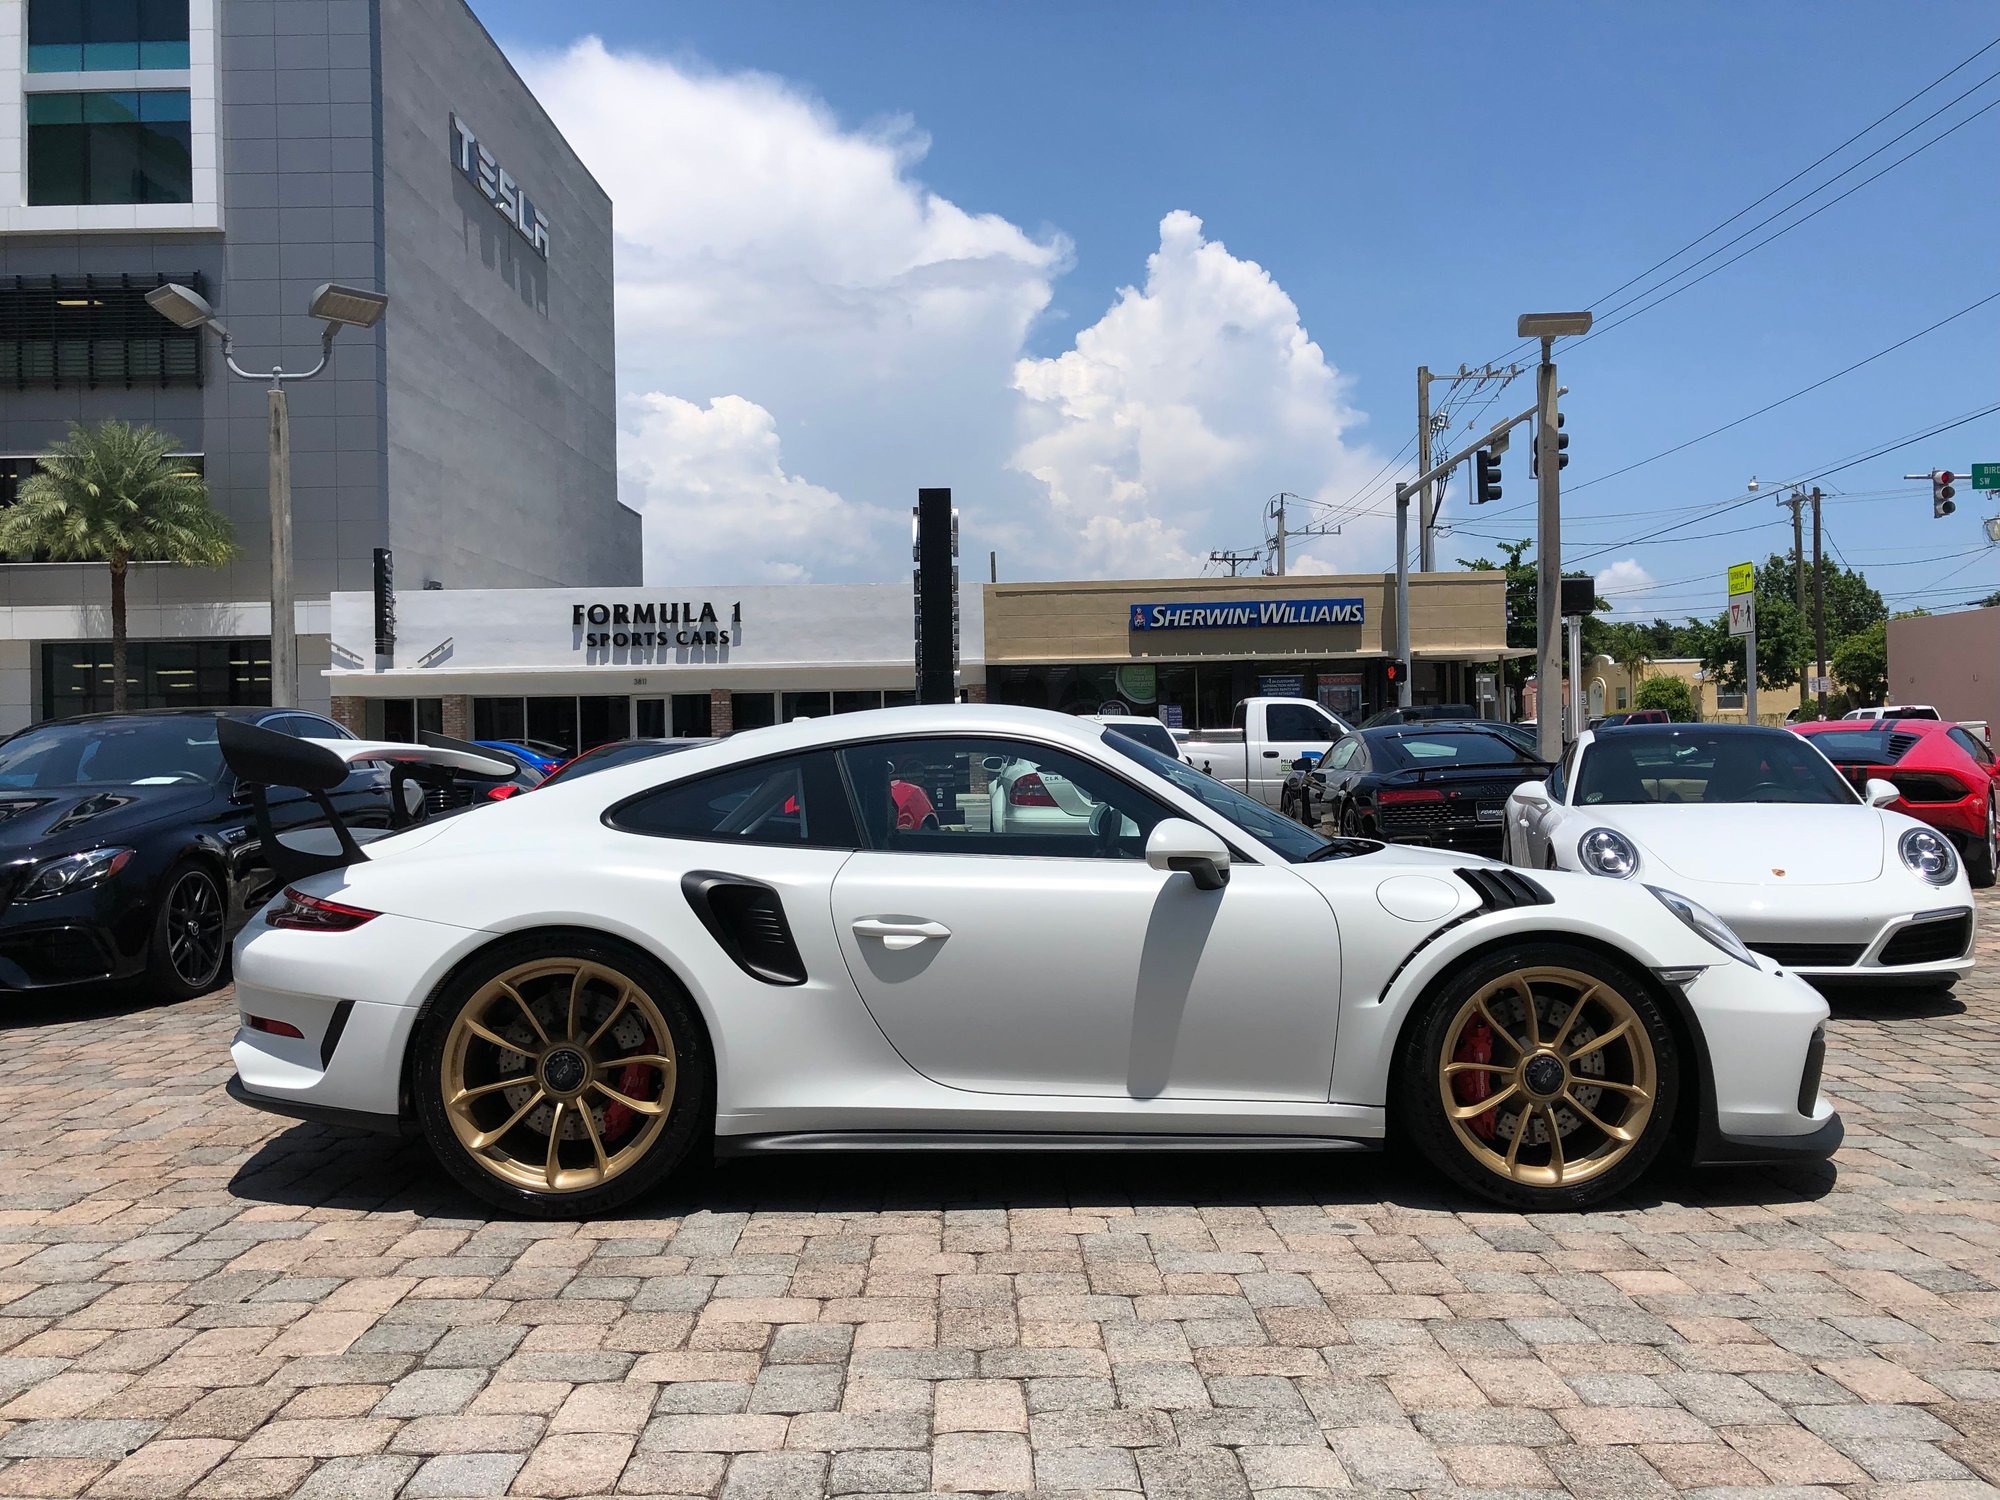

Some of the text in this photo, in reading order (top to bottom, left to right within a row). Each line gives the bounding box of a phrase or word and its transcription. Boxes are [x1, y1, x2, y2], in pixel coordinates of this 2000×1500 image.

[454, 116, 550, 258] TESLA
[573, 601, 742, 625] FORMULA 1
[1150, 603, 1361, 627] SHERWIN-WILLIAMS
[587, 631, 730, 647] SPORTS CARS
